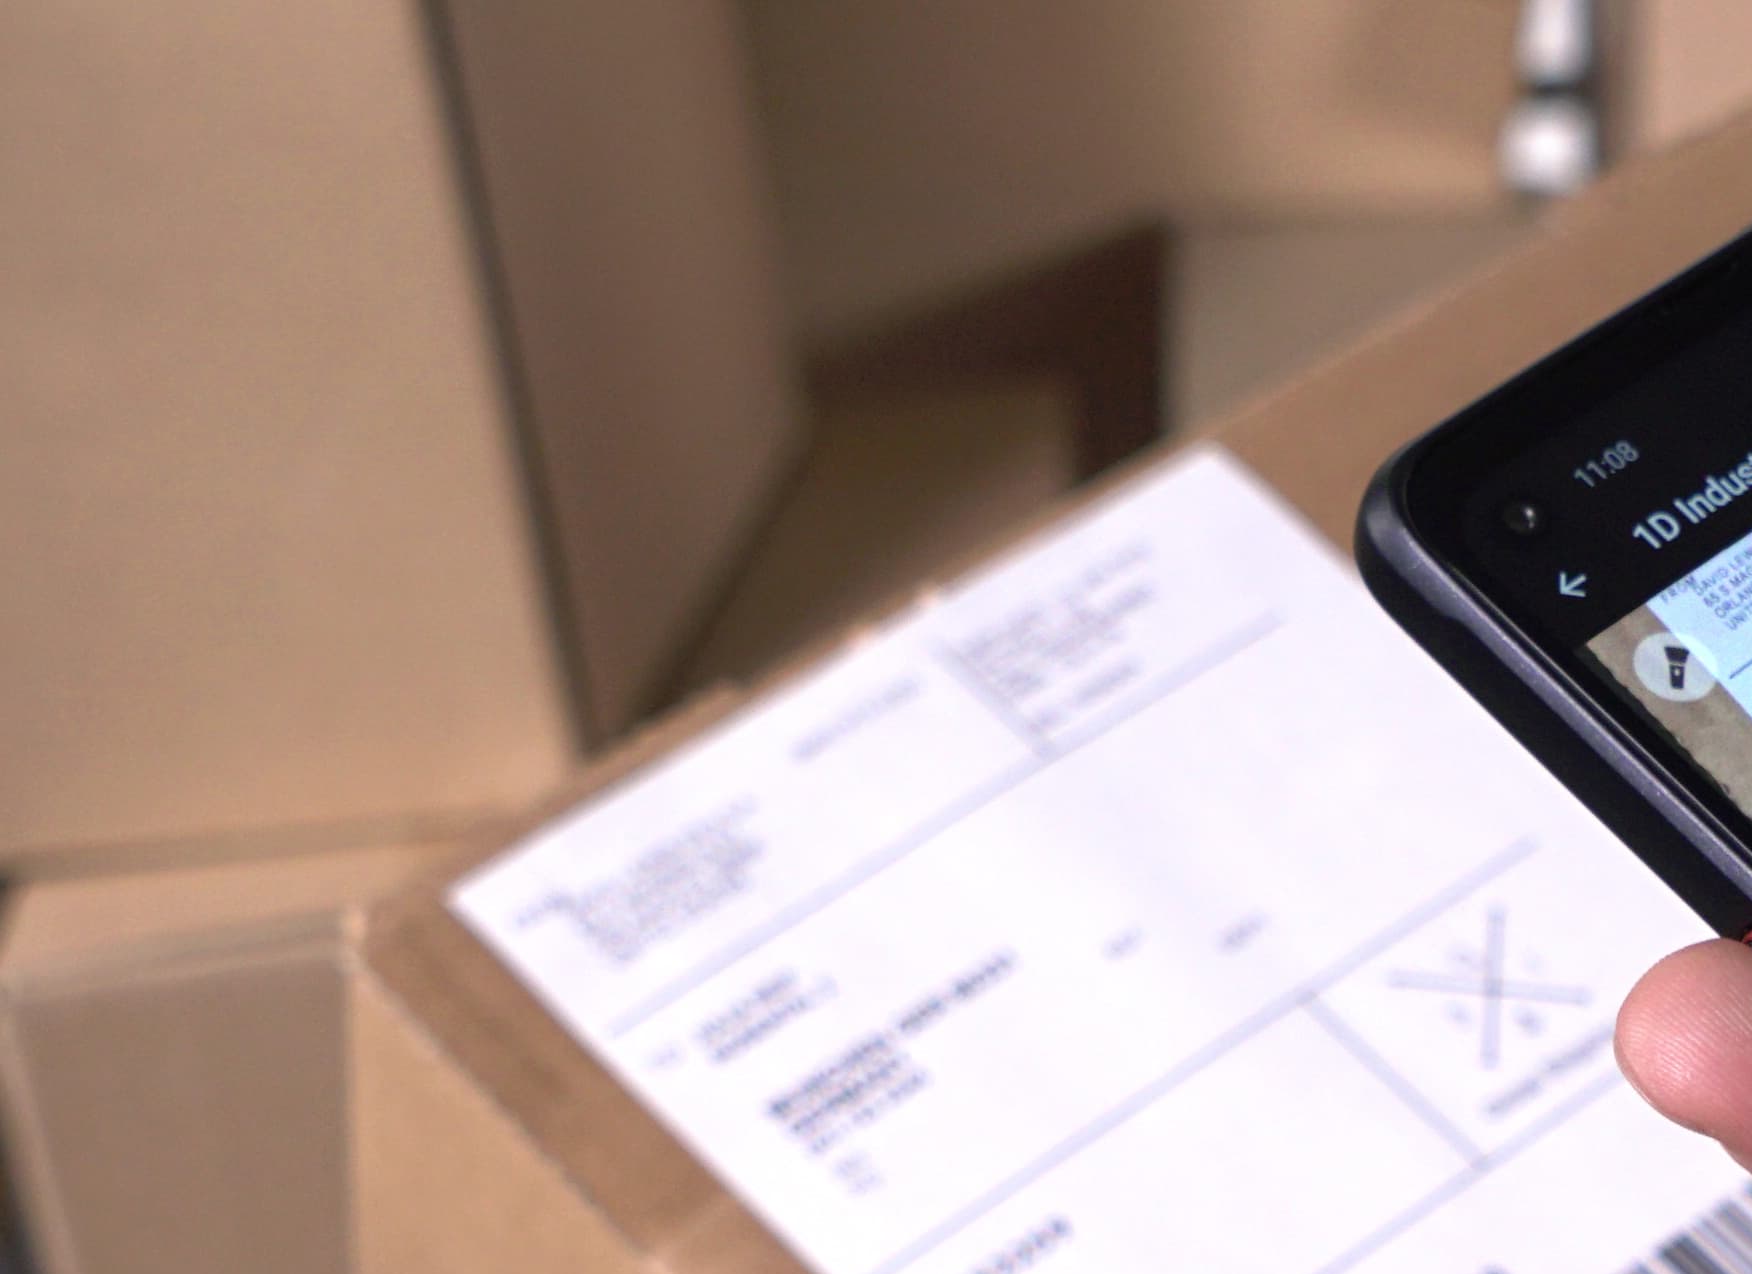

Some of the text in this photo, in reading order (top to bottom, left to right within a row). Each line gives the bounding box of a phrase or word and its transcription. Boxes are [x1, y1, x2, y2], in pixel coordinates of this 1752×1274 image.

[1569, 437, 1643, 491] 11:08
[1626, 506, 1688, 554] 1D
[1689, 565, 1733, 598] DAVID
